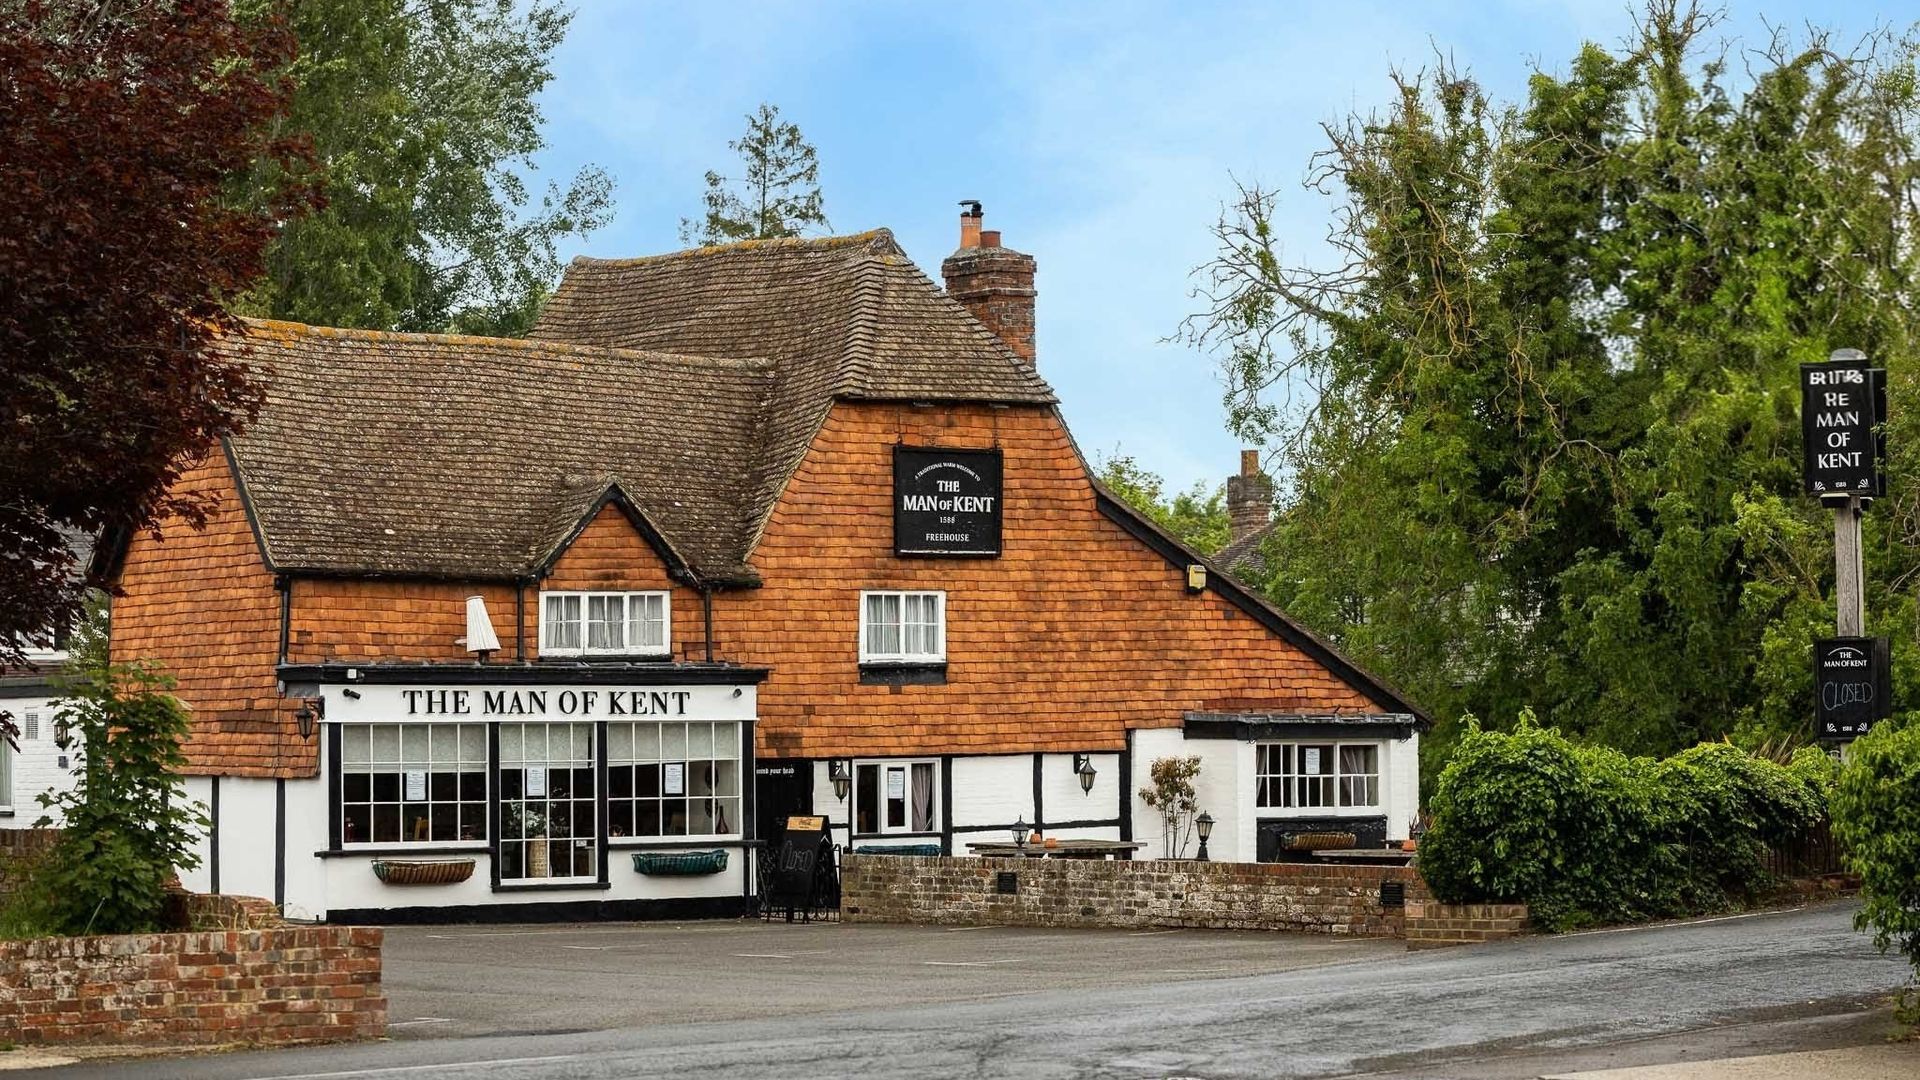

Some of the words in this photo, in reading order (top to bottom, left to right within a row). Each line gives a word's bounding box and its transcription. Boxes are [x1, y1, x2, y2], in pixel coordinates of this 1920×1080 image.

[1816, 412, 1859, 428] MAN
[1827, 432, 1850, 448] OF
[1818, 452, 1862, 468] KENT
[937, 480, 960, 492] THE
[903, 495, 937, 511] MAN
[953, 496, 994, 512] KENT
[926, 533, 970, 542] FREEHOUSE
[402, 690, 471, 714] THE
[483, 690, 547, 714] MAN
[558, 690, 598, 715] OF
[608, 692, 691, 715] KENT
[1822, 681, 1873, 711] CLOSED
